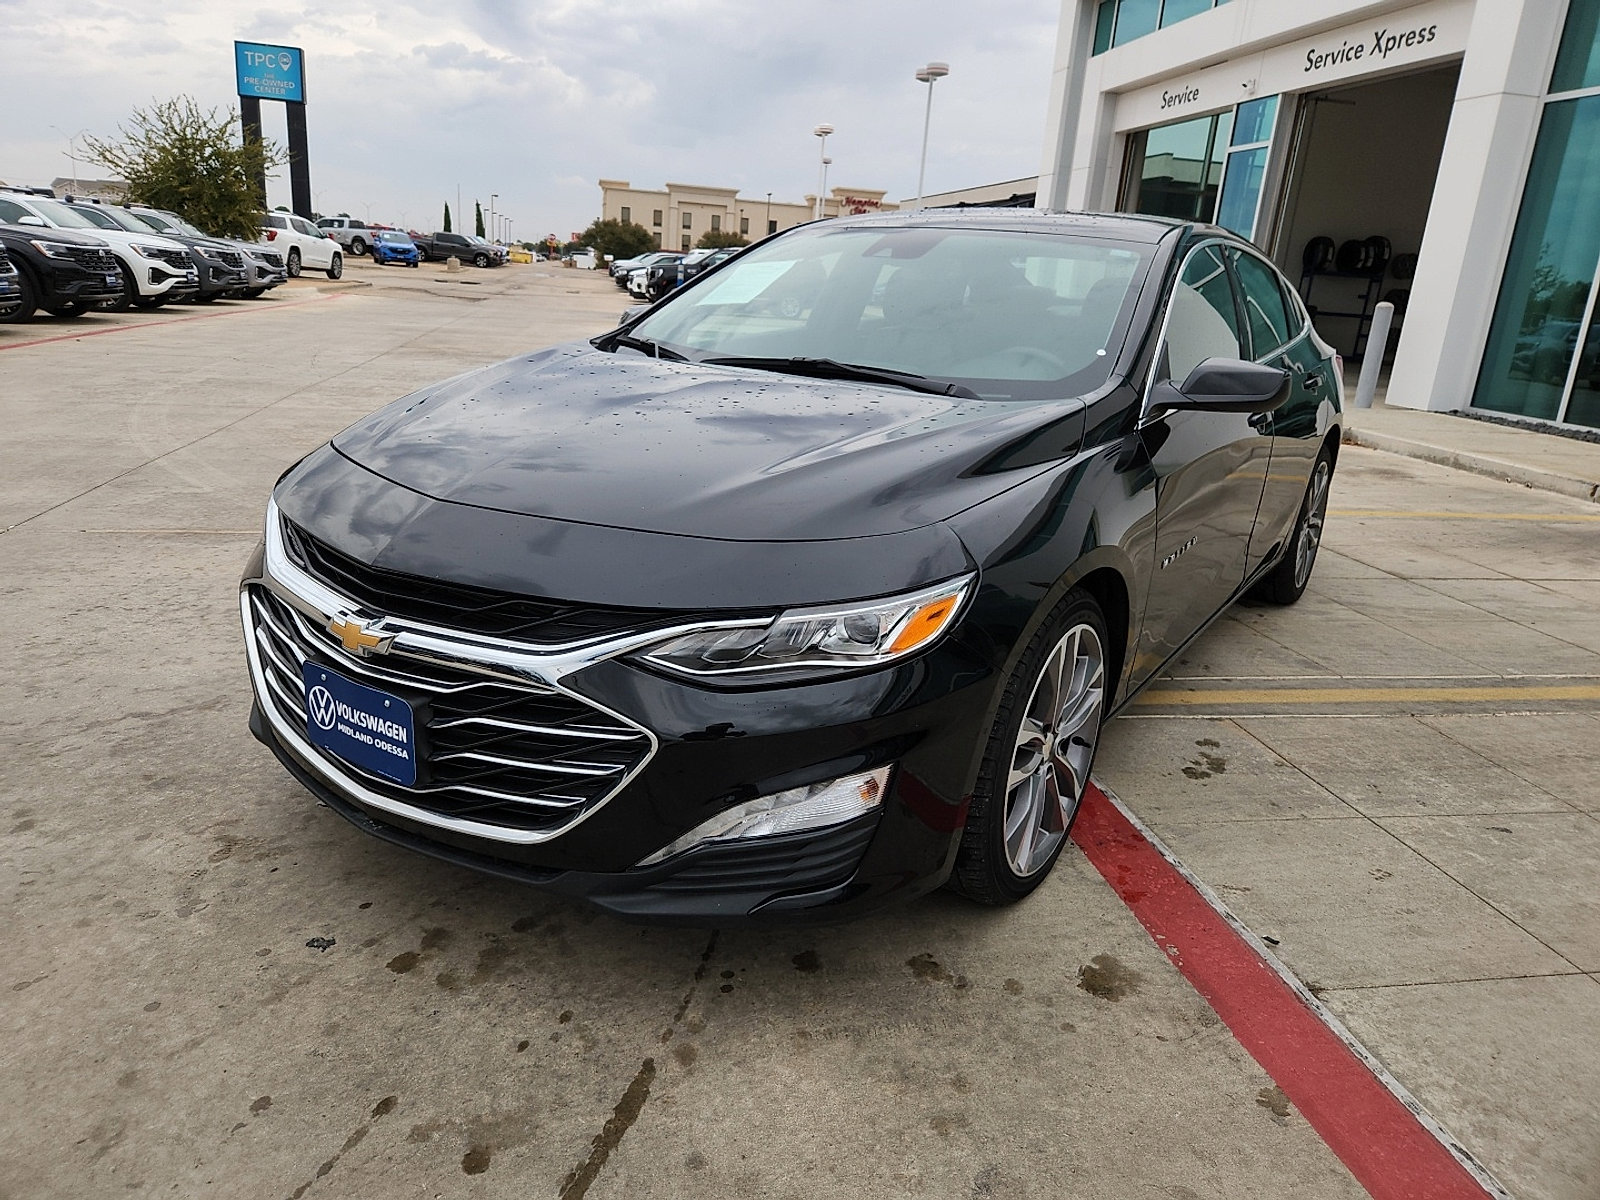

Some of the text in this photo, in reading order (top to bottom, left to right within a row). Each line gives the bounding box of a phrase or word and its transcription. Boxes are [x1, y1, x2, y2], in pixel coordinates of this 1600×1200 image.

[244, 51, 276, 68] TPC
[1303, 24, 1437, 72] Service Xpress
[254, 85, 286, 95] CENTER
[1160, 86, 1199, 109] Service
[335, 700, 407, 743] VOLKSWAGEN
[337, 722, 409, 760] MIDLAND ODESSA
